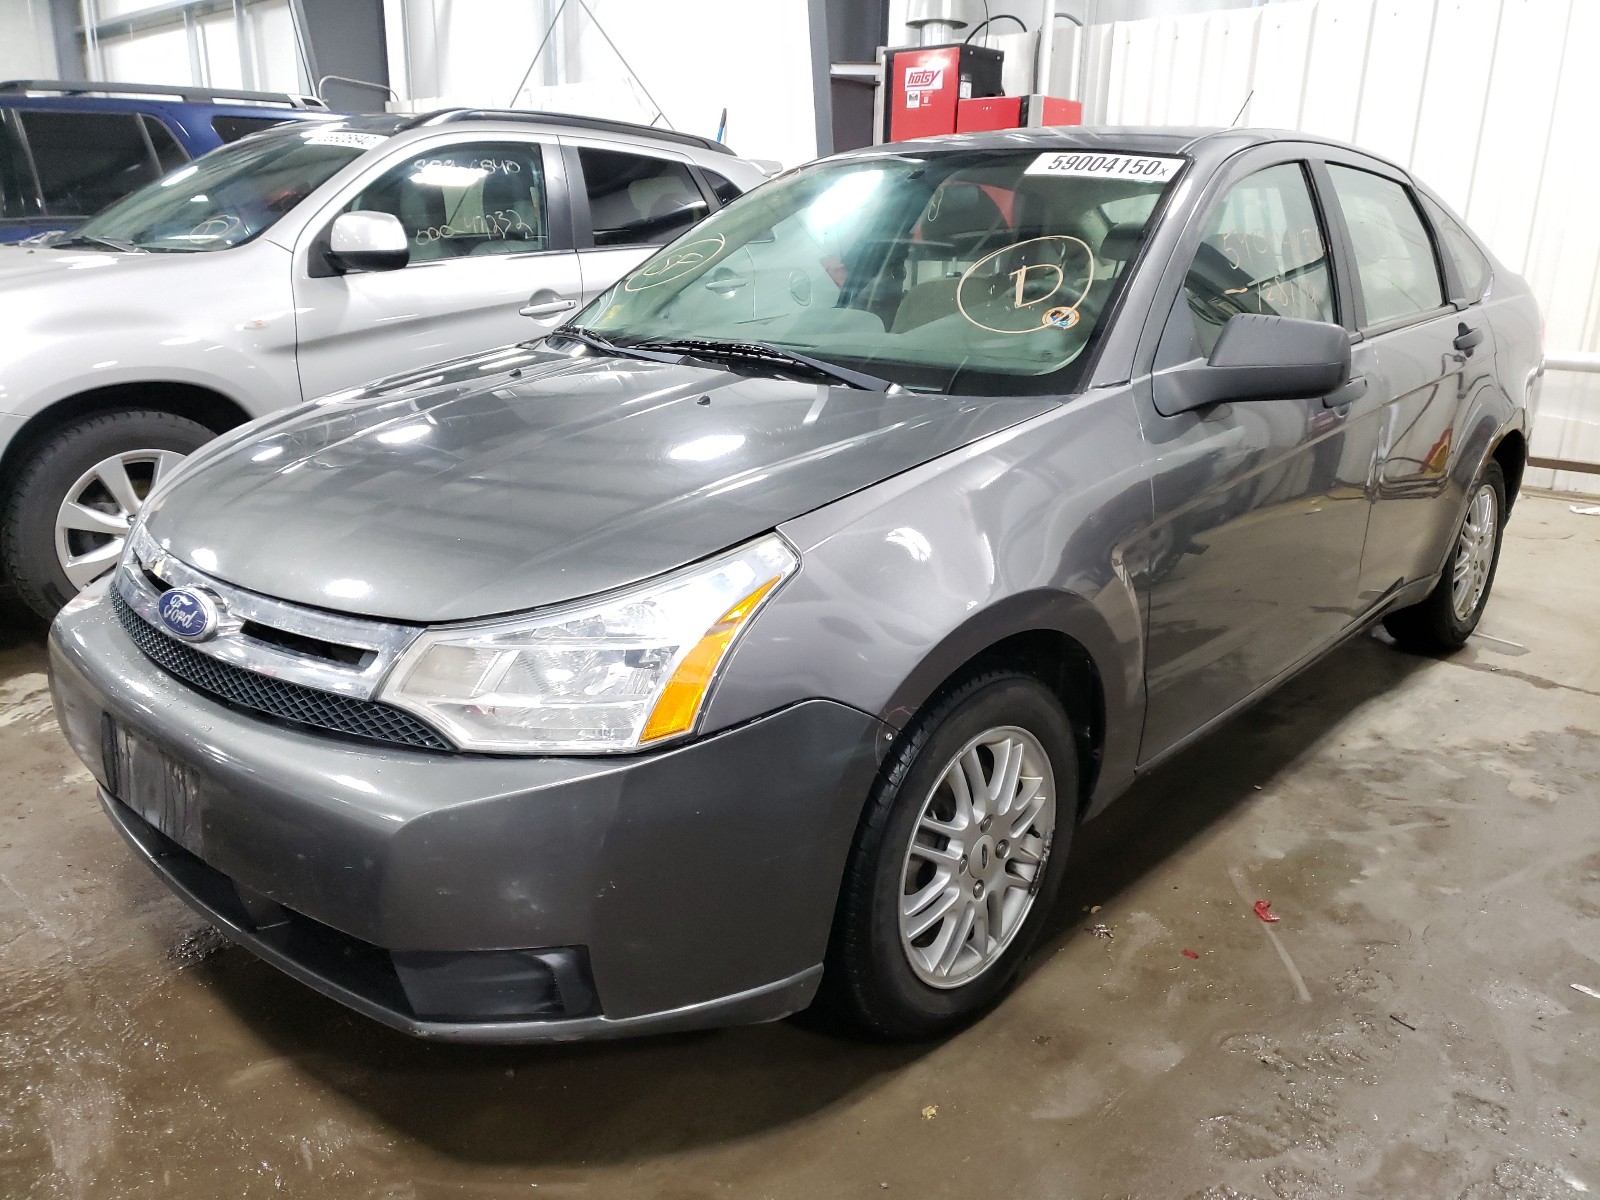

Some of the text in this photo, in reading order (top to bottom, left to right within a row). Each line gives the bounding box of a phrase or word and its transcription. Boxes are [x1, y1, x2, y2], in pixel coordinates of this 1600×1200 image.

[907, 70, 941, 87] hotsy
[1009, 264, 1064, 309] D
[163, 594, 200, 629] Ford
